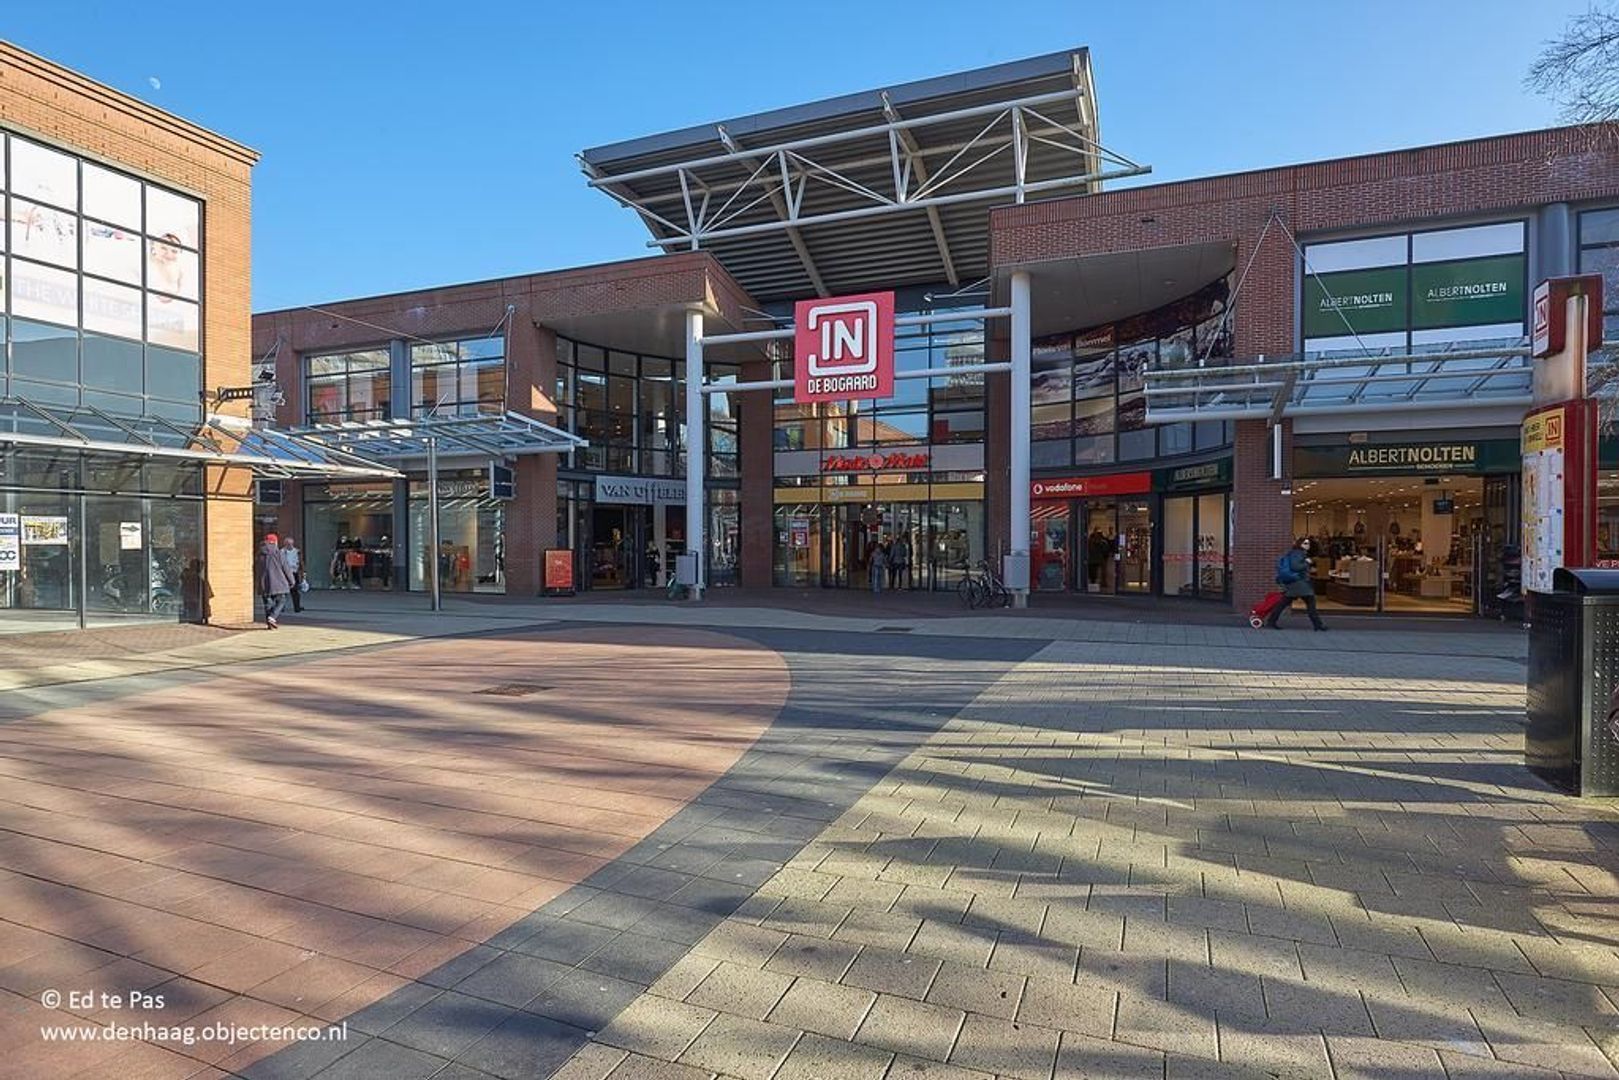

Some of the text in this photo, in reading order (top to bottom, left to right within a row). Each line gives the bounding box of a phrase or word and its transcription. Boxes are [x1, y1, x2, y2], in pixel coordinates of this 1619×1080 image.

[1427, 283, 1506, 298] ALBERTNOLTEN
[822, 318, 863, 360] IN
[808, 375, 877, 393] DE BOGAARD
[1349, 446, 1475, 464] ALBERTNOLTEN
[602, 484, 630, 498] VAN
[1045, 482, 1082, 493] vodafone
[0, 516, 16, 525] UR
